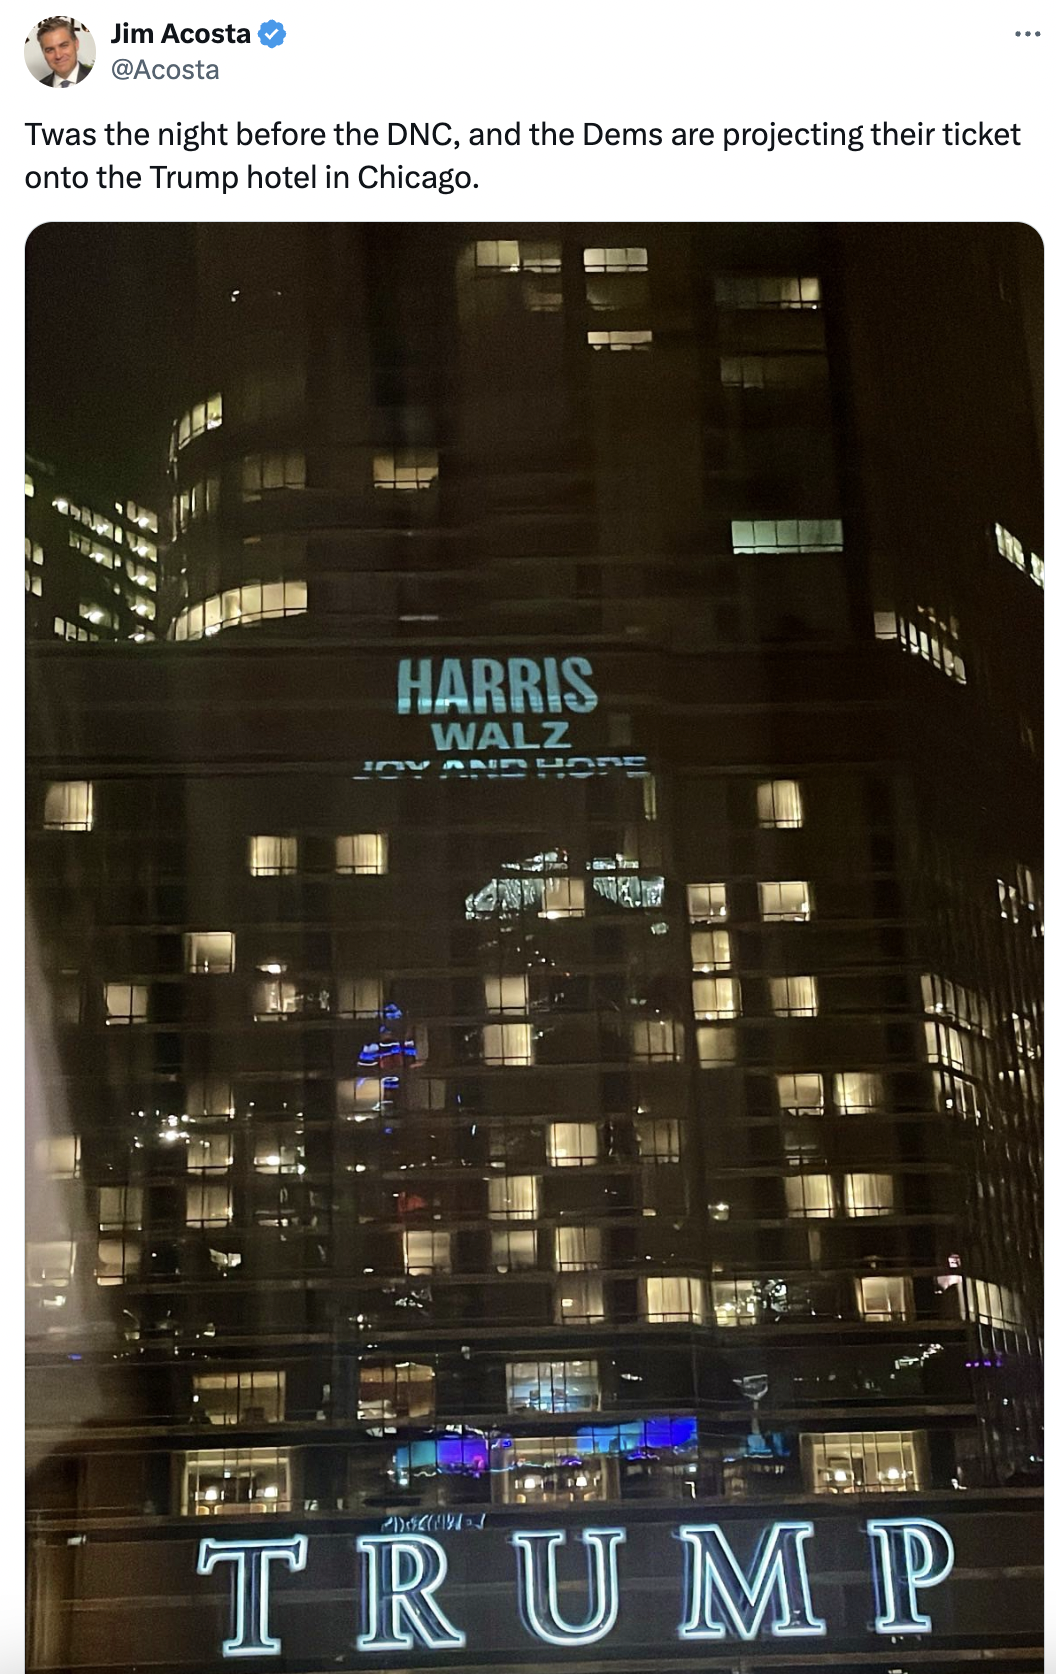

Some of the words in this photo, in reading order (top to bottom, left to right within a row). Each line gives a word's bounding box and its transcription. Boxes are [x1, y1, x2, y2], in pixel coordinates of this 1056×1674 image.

[397, 656, 598, 715] HARRIS
[430, 721, 573, 751] WALZ
[197, 1517, 955, 1657] TRUMP
